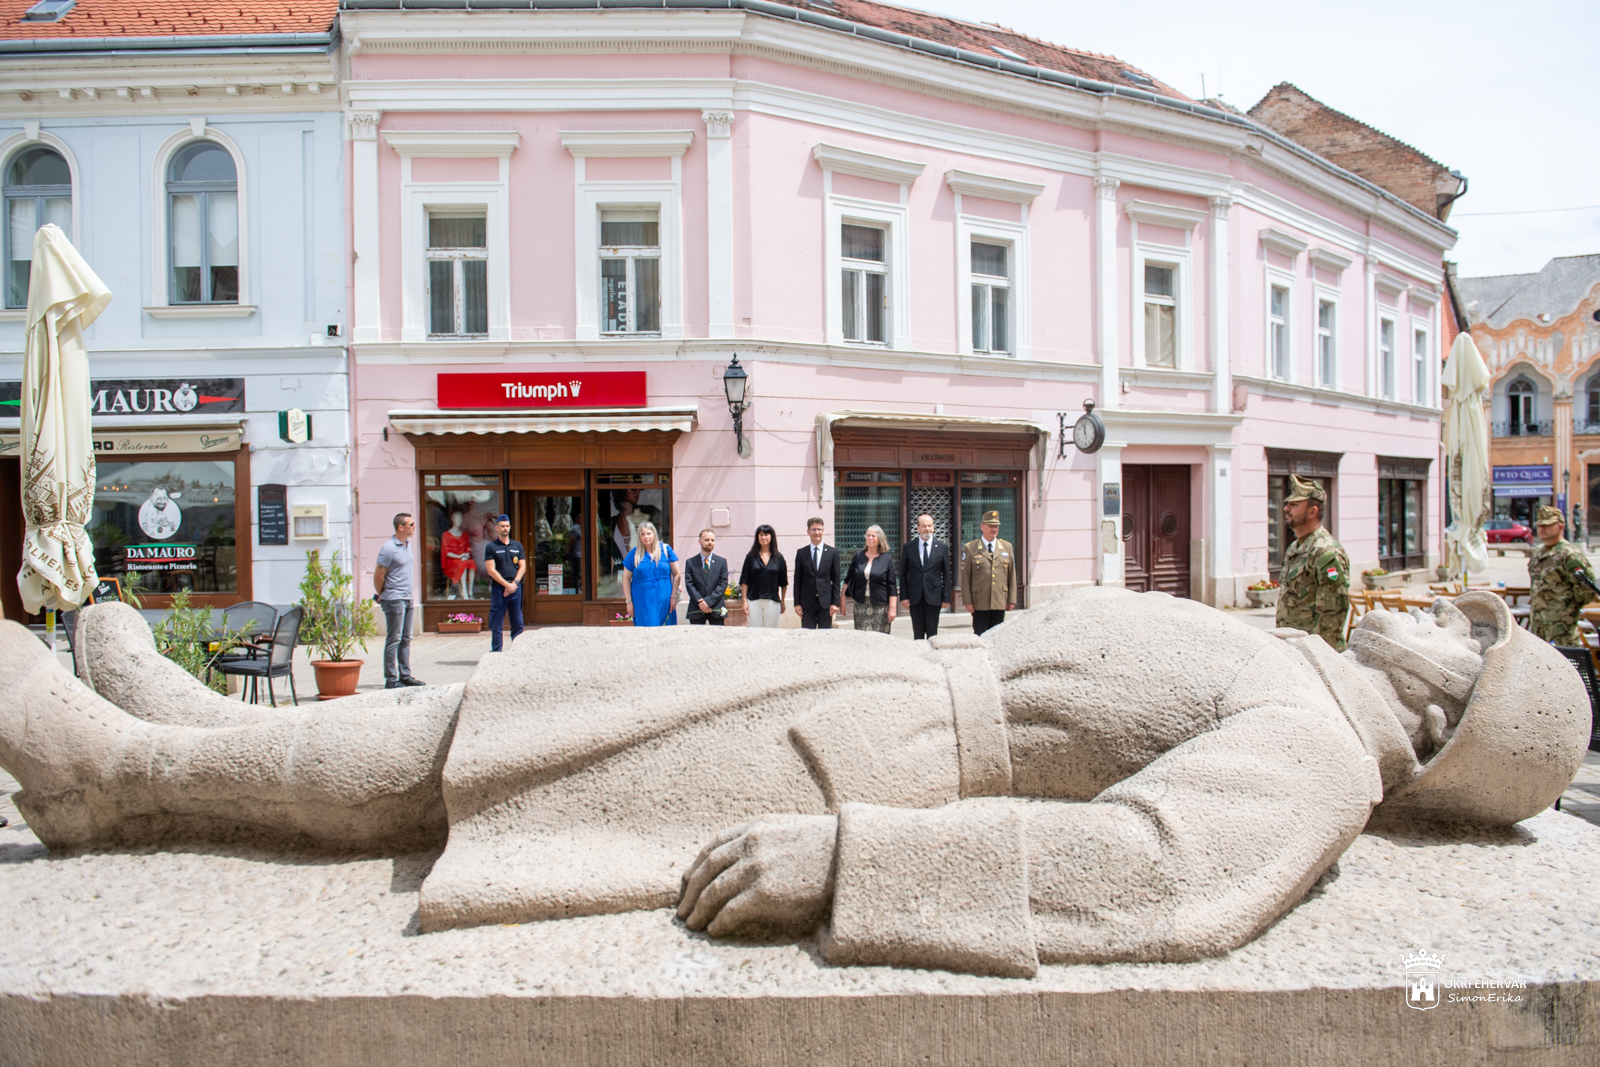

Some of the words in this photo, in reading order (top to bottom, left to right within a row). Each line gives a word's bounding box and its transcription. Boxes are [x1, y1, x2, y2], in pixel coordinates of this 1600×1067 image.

[501, 382, 567, 401] Triumph
[116, 438, 169, 451] Ristorante
[1519, 470, 1550, 480] QUICK
[126, 547, 145, 559] DA
[146, 546, 196, 559] MAURO
[127, 563, 163, 571] Ristorante
[169, 562, 198, 570] Pizzeria
